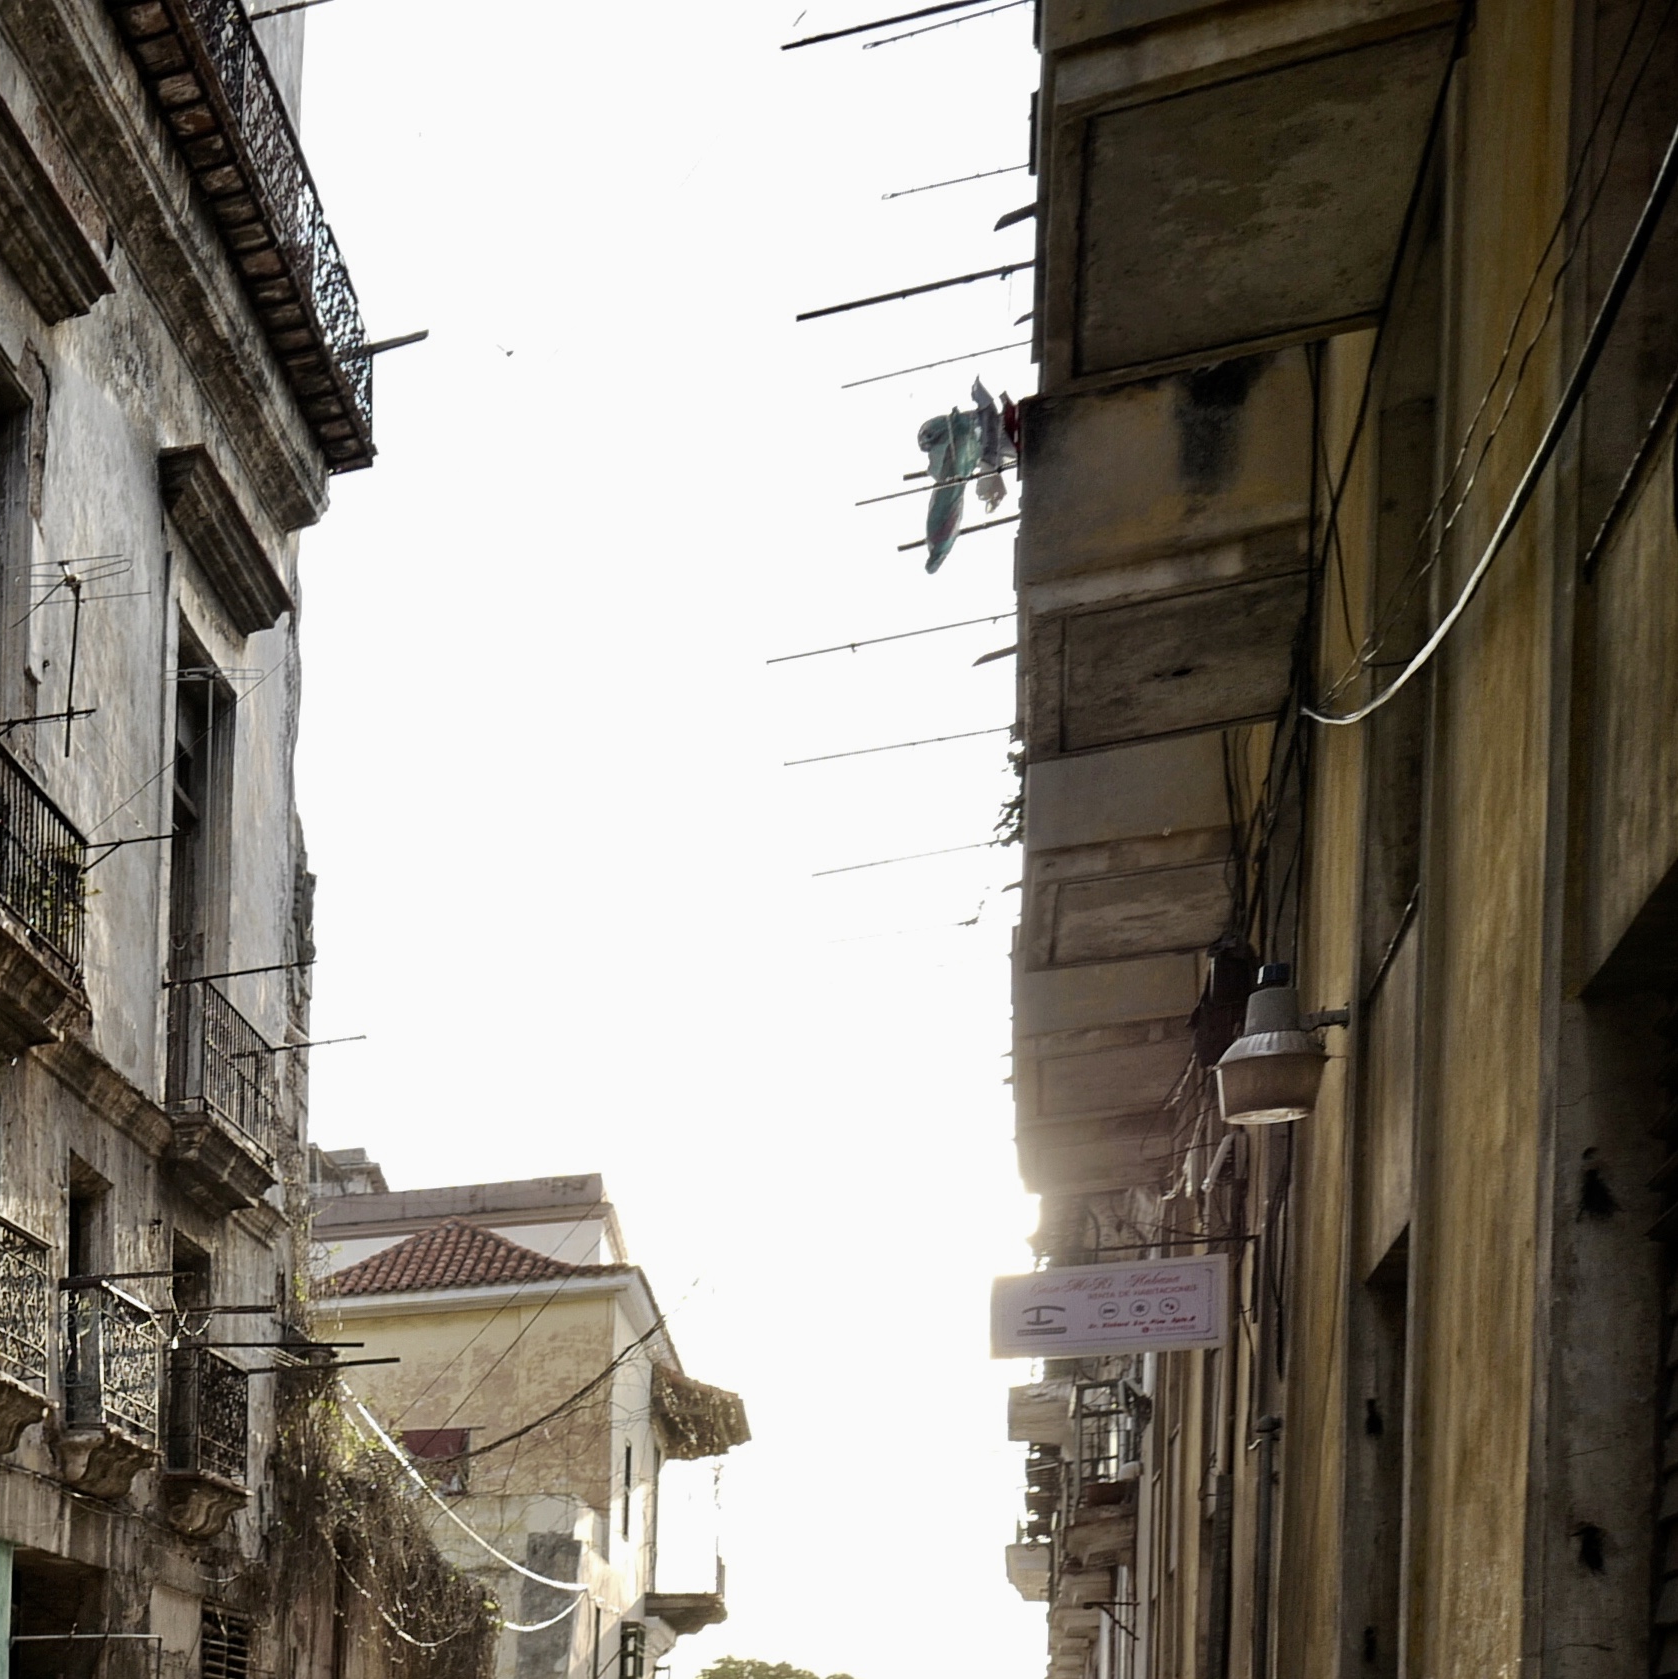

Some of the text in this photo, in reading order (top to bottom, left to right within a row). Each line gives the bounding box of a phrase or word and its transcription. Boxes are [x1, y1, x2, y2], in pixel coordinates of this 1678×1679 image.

[1126, 1271, 1180, 1287] Habana
[1088, 1283, 1198, 1300] RENTA DE HABITACIONES
